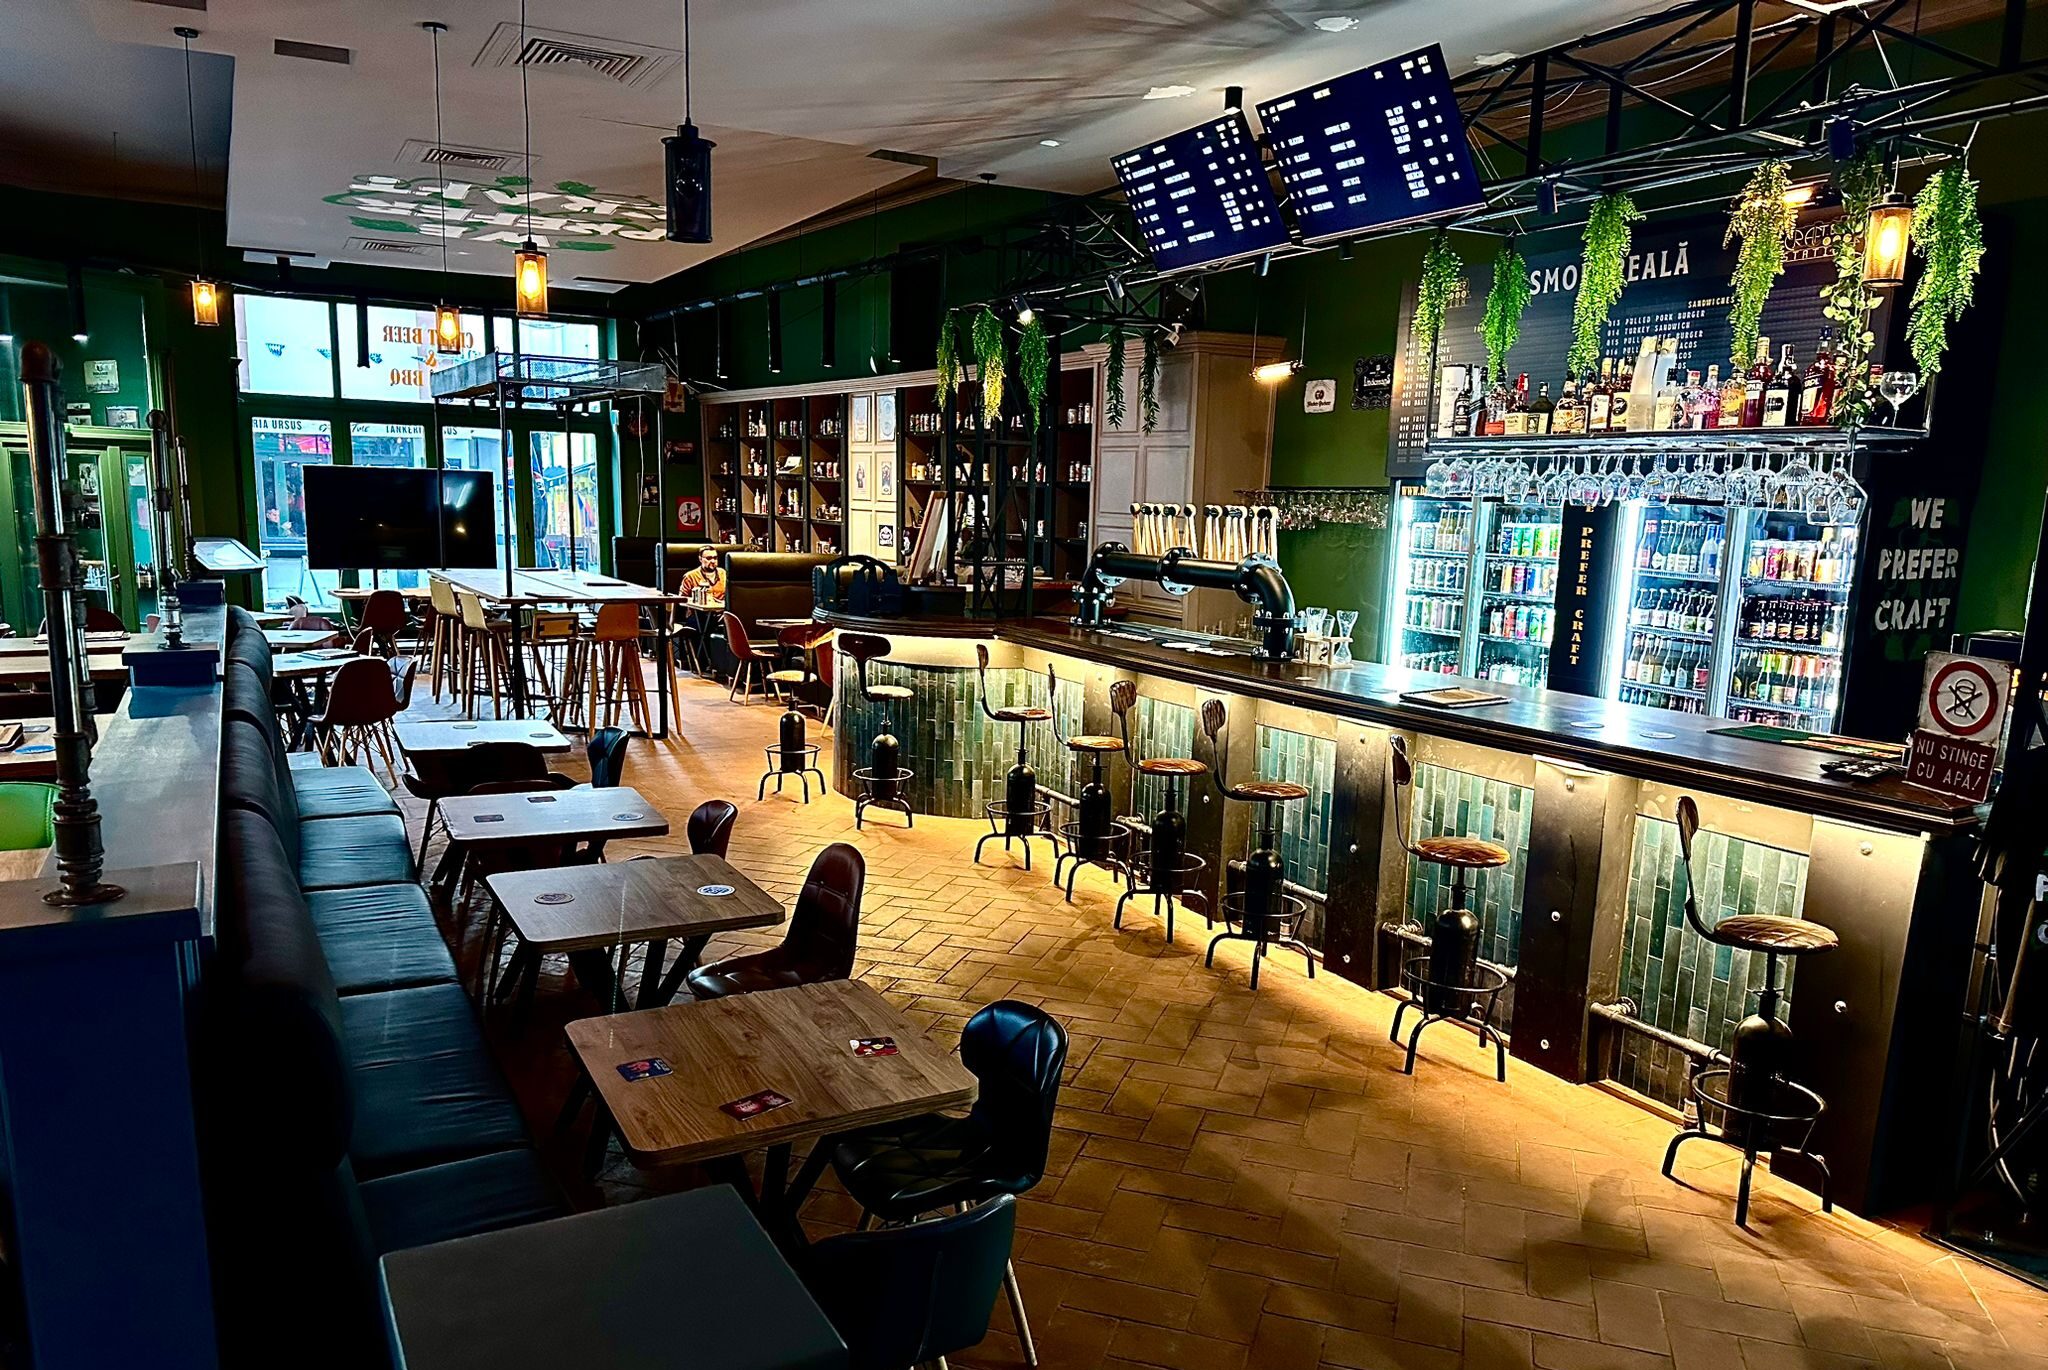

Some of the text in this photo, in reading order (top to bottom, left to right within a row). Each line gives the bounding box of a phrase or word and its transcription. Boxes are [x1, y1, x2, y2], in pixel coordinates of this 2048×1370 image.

[1688, 296, 1735, 309] SANDWICHES
[1625, 316, 1651, 325] PULLED
[1656, 313, 1674, 322] PORK
[1678, 310, 1706, 320] BURGER
[1624, 325, 1650, 335] TURKEY
[1654, 322, 1691, 332] SANDWICH
[1676, 330, 1704, 340] BURGER
[1622, 346, 1639, 354] PULL
[1678, 341, 1698, 350] ACOS
[272, 420, 302, 430] URSUS
[1911, 497, 1945, 529] WE
[1576, 526, 1594, 596] PREFER
[1878, 548, 1959, 580] PREFER
[1874, 597, 1951, 630] CRAFT
[1569, 609, 1584, 665] CRAFT
[1916, 738, 1988, 770] NU STINGE
[1916, 762, 1936, 779] CU
